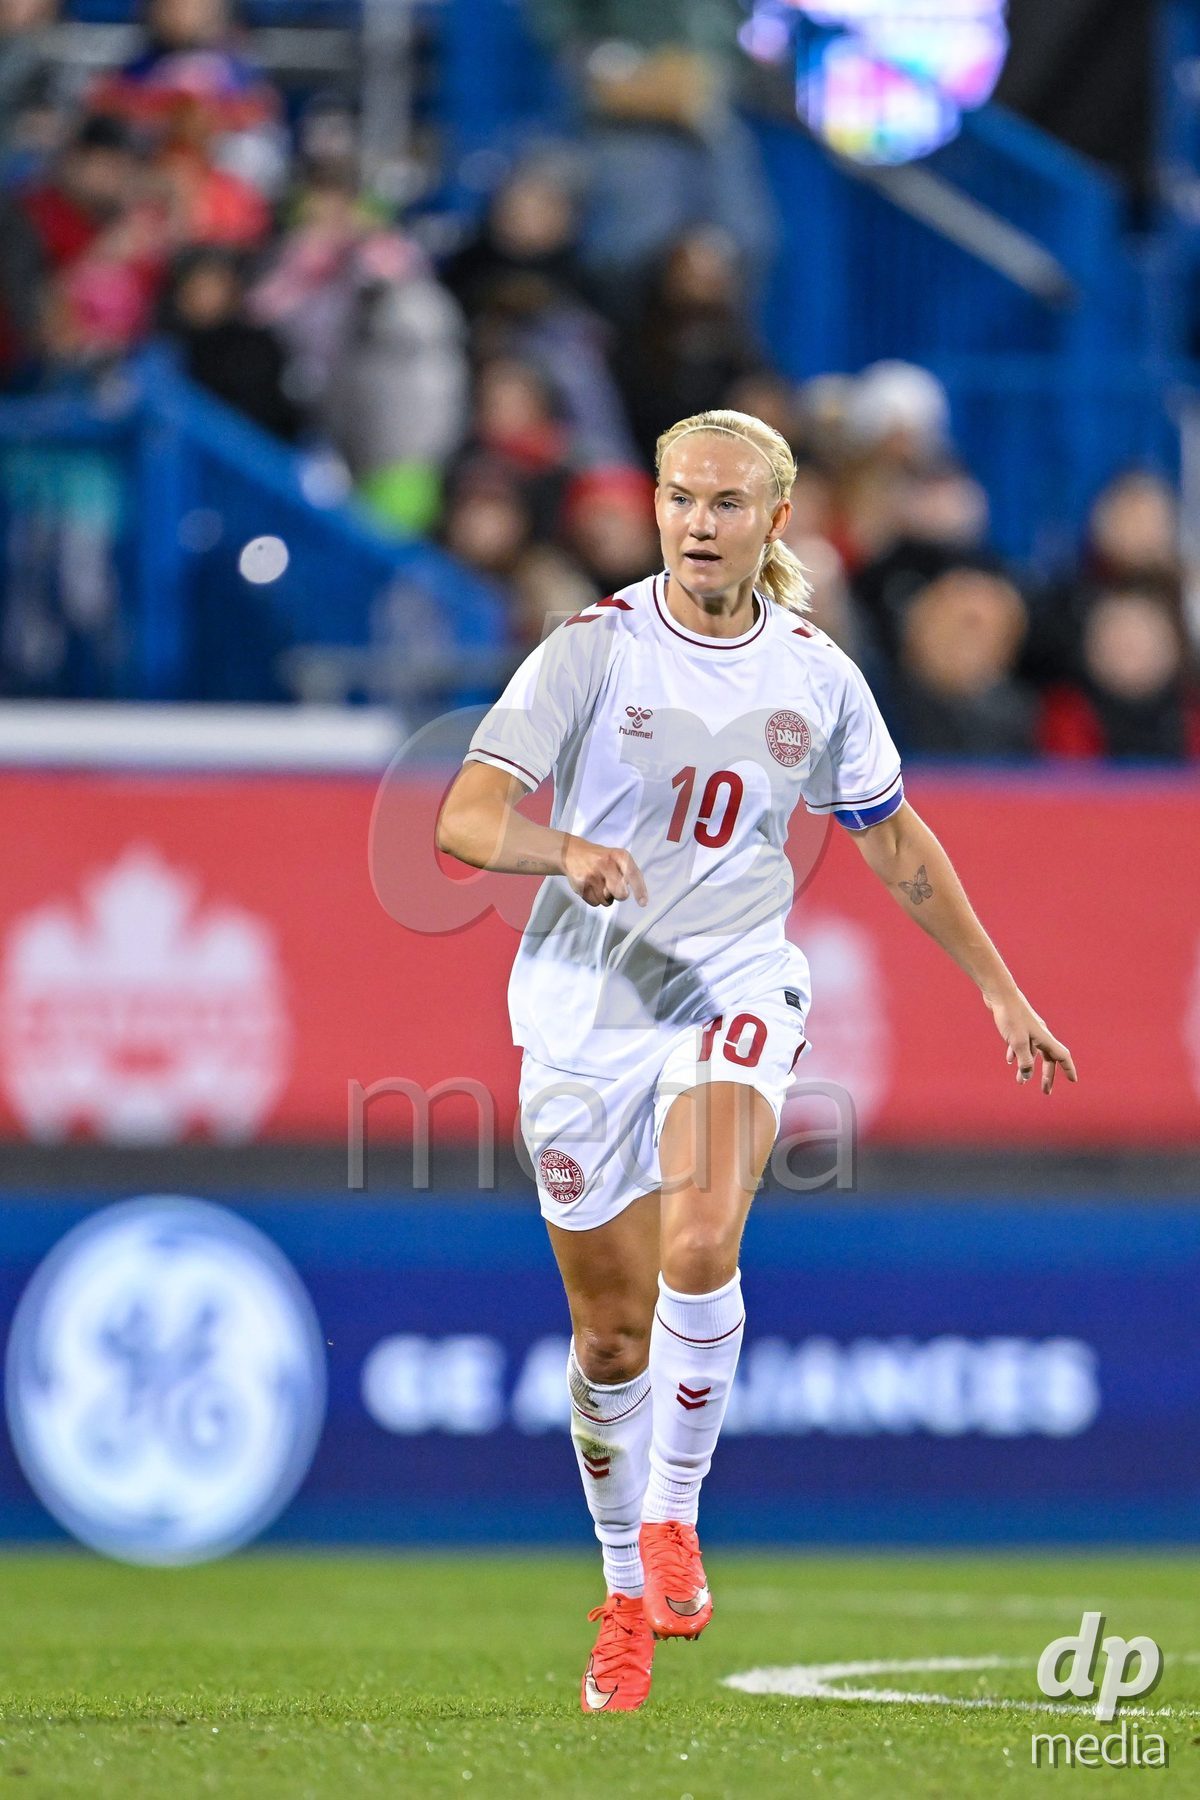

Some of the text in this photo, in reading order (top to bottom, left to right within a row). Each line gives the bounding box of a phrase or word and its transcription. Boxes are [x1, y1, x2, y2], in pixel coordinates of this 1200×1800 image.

[618, 725, 654, 739] hummel
[768, 724, 780, 756] DANSK
[798, 731, 810, 759] UNION
[775, 728, 802, 746] DBU
[666, 766, 744, 848] 10
[698, 1013, 768, 1067] 10
[546, 1168, 573, 1183] DBU
[571, 1165, 582, 1193] UNION
[556, 1193, 575, 1201] 1889
